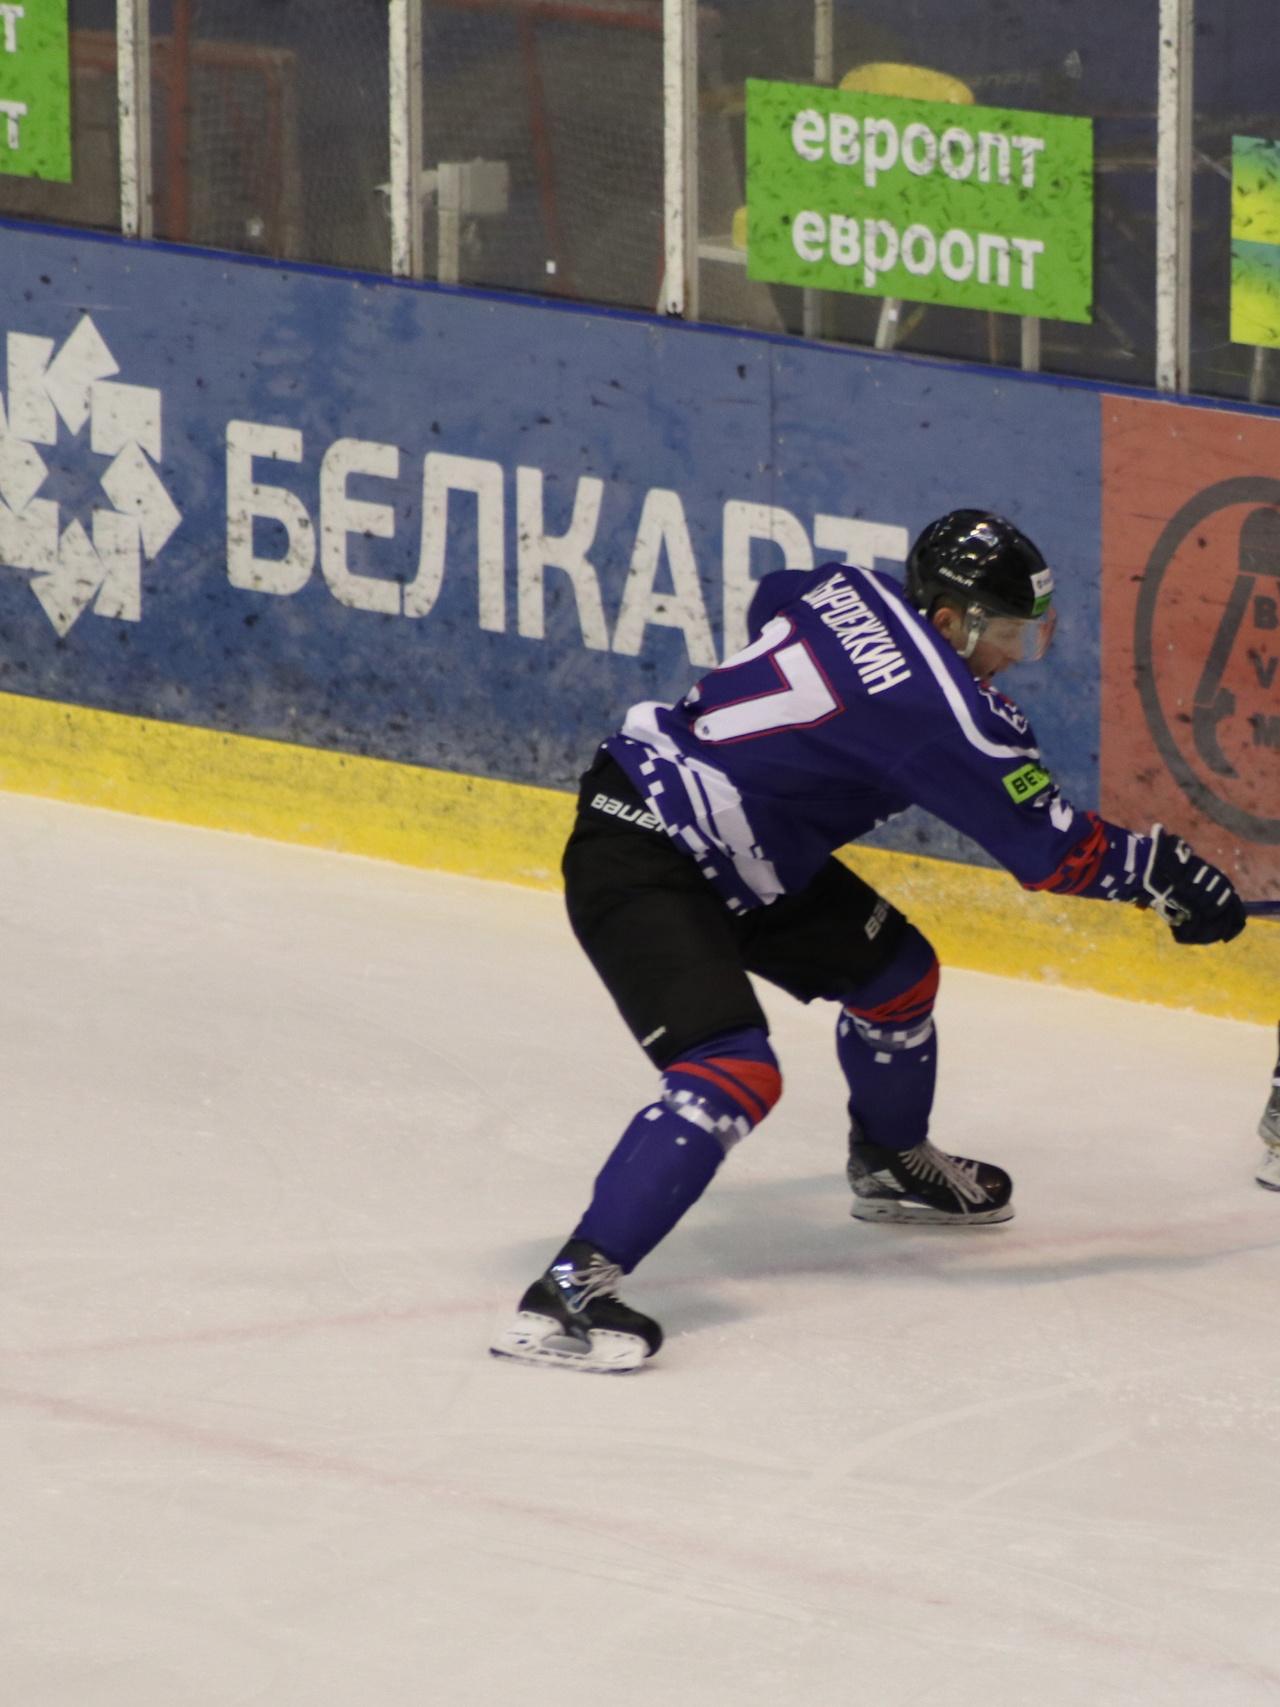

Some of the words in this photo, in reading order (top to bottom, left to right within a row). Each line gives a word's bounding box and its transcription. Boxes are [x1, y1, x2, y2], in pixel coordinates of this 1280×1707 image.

[792, 108, 1045, 188] евроопт
[792, 210, 1045, 290] евроопт
[226, 419, 909, 669] БЕЛКАРТ
